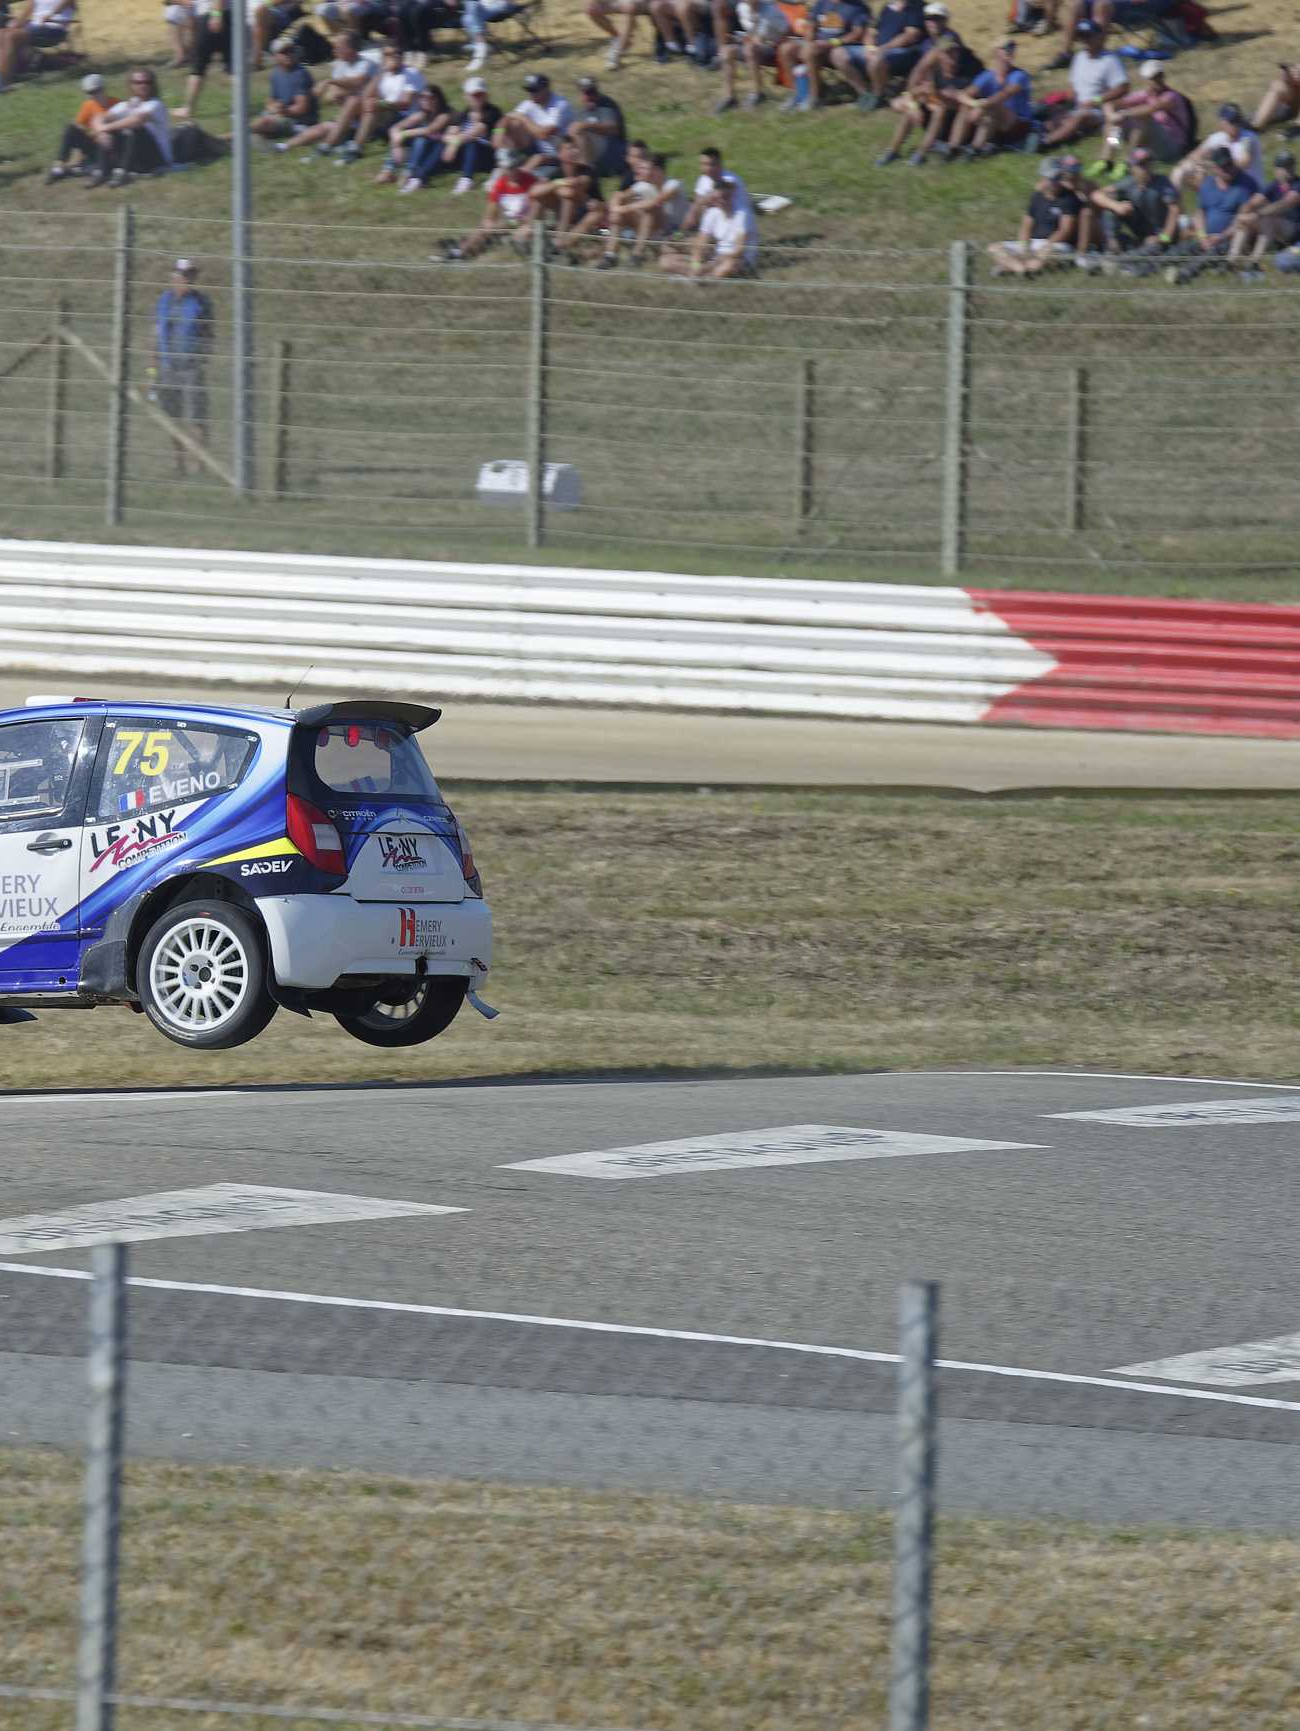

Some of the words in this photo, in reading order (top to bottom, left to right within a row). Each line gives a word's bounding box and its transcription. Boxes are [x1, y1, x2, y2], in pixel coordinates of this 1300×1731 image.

[113, 731, 172, 776] 75
[149, 772, 220, 803] EVENO
[136, 809, 175, 843] NY
[400, 837, 418, 857] NY
[240, 860, 293, 876] SADEV
[0, 920, 61, 933] Ensemble
